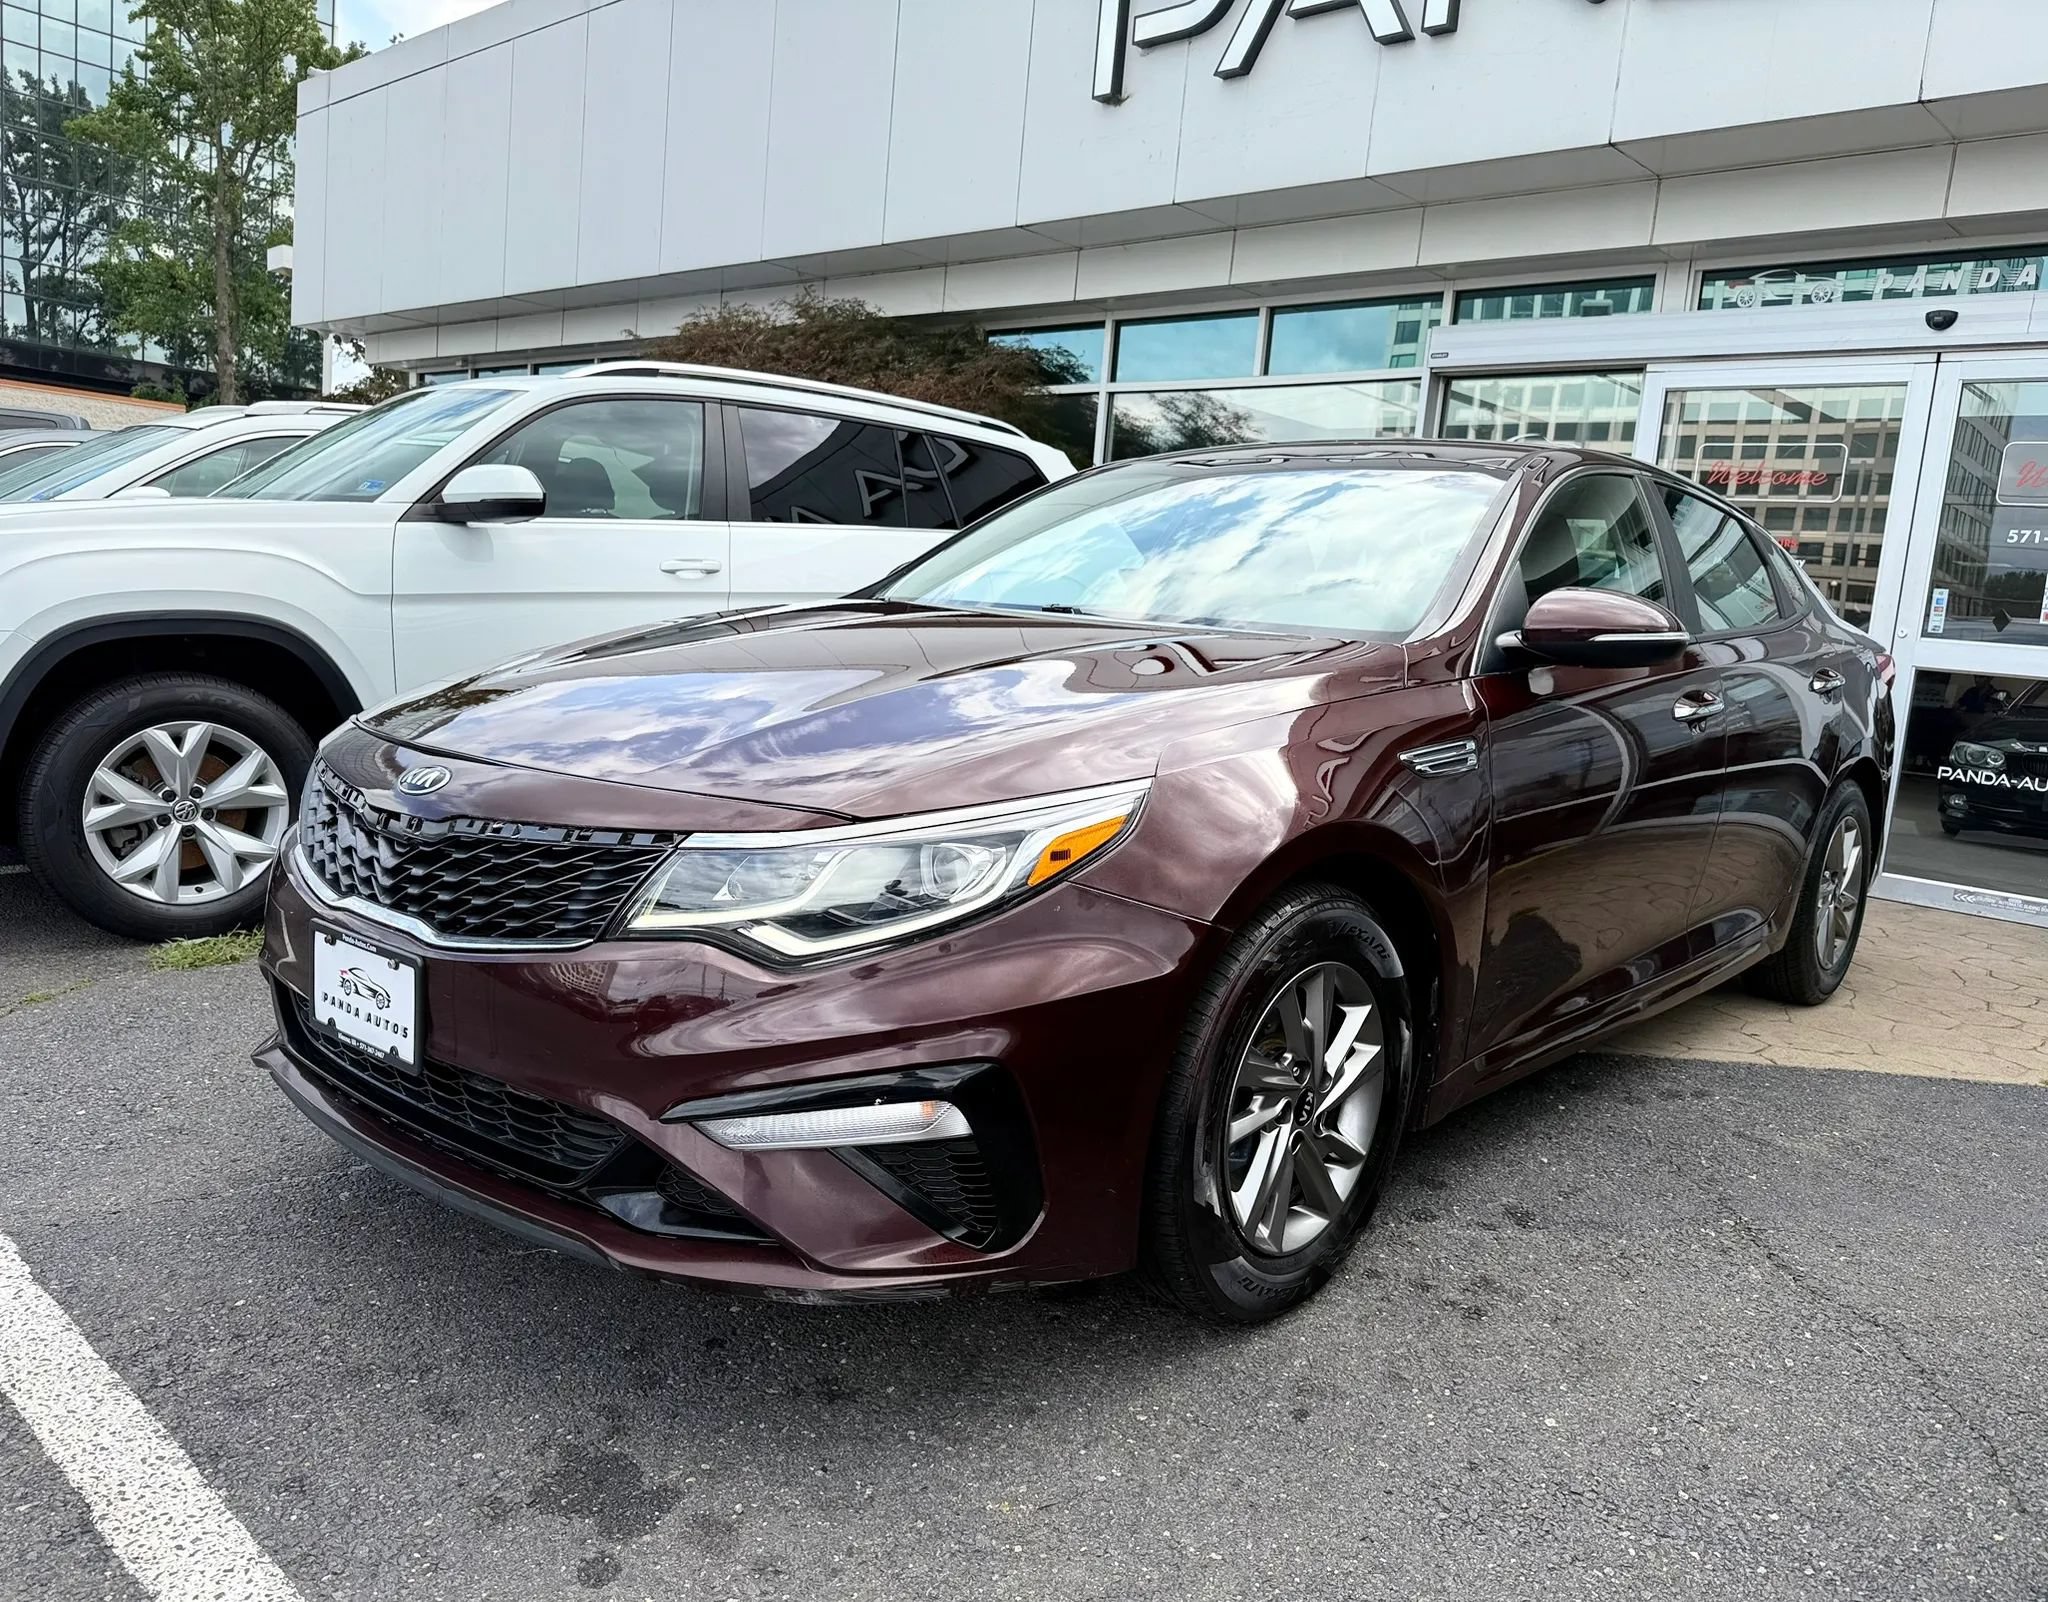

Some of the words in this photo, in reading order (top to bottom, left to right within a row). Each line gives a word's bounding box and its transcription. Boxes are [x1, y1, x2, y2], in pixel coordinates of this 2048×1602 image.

[1874, 263, 2037, 294] PANDA
[1707, 460, 1829, 486] Welcome
[400, 767, 444, 789] KIA
[322, 991, 360, 1019] PANDA
[364, 1012, 408, 1039] AUTOS
[1299, 1091, 1314, 1121] KIA
